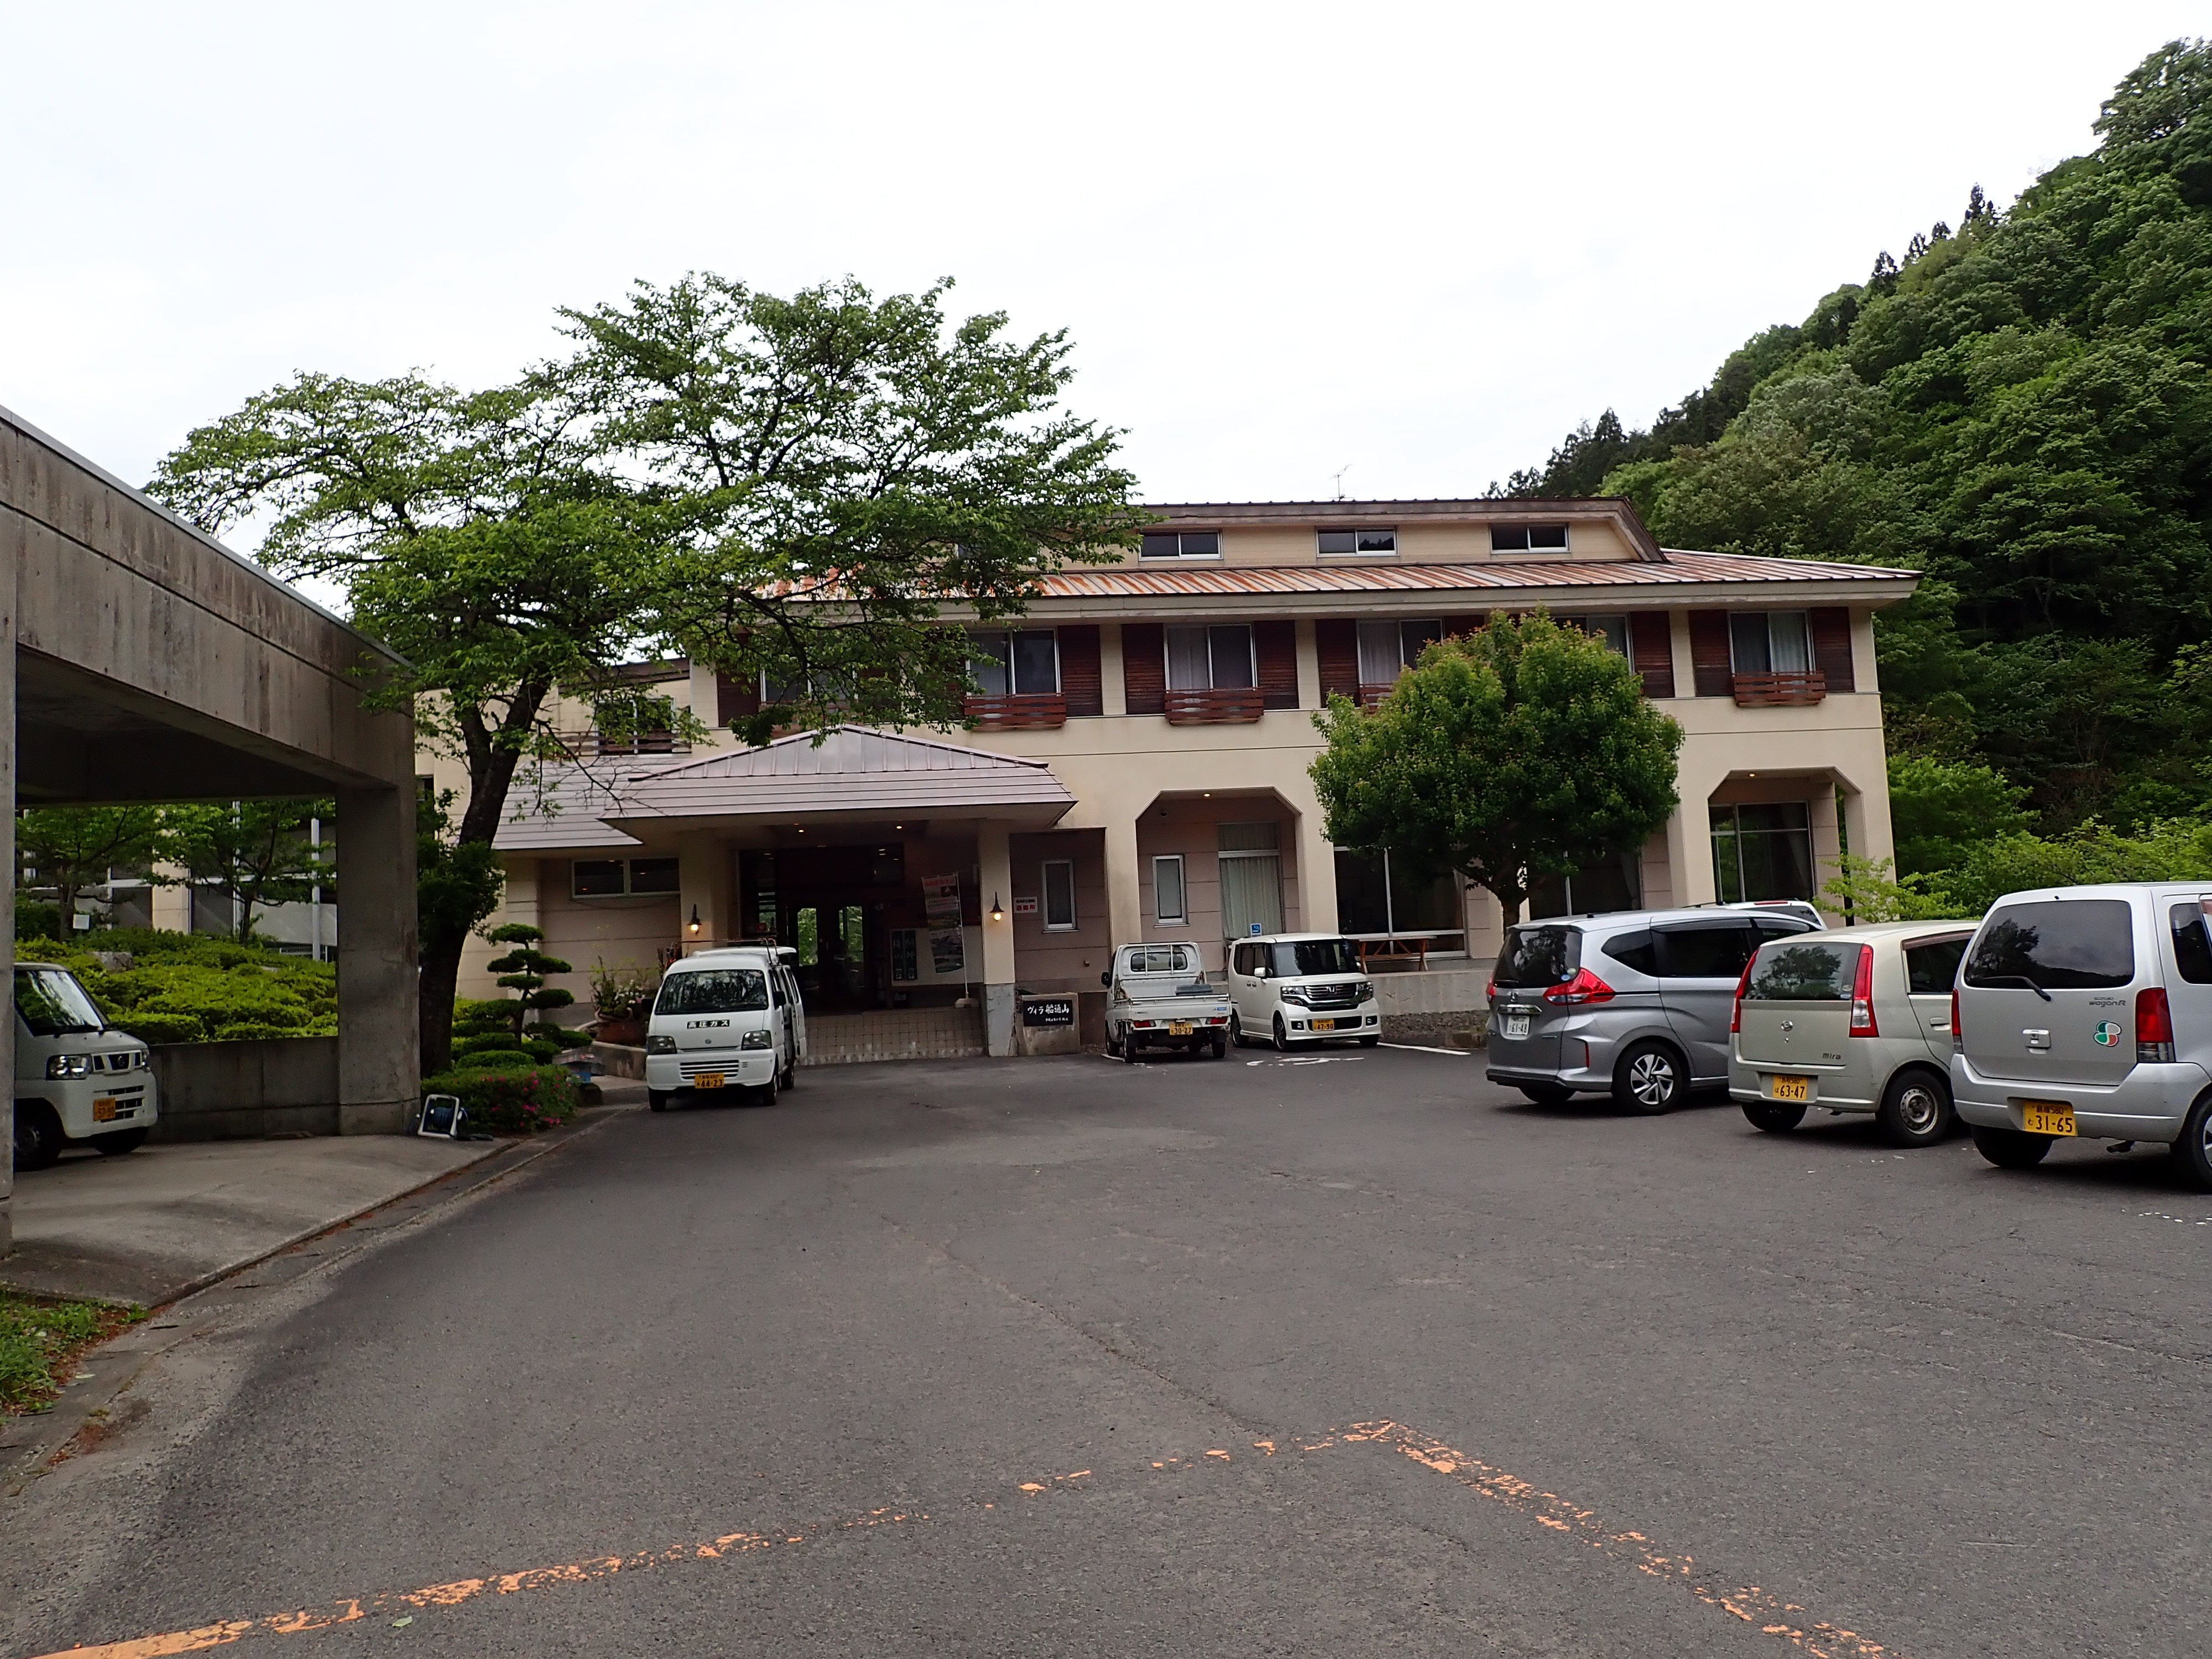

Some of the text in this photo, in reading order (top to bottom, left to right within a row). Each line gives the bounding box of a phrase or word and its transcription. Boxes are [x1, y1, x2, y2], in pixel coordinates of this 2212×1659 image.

[1027, 1004, 1070, 1015] ヴィラ船通山
[1780, 1085, 1805, 1098] 63-47
[2036, 1115, 2073, 1133] 31-65
